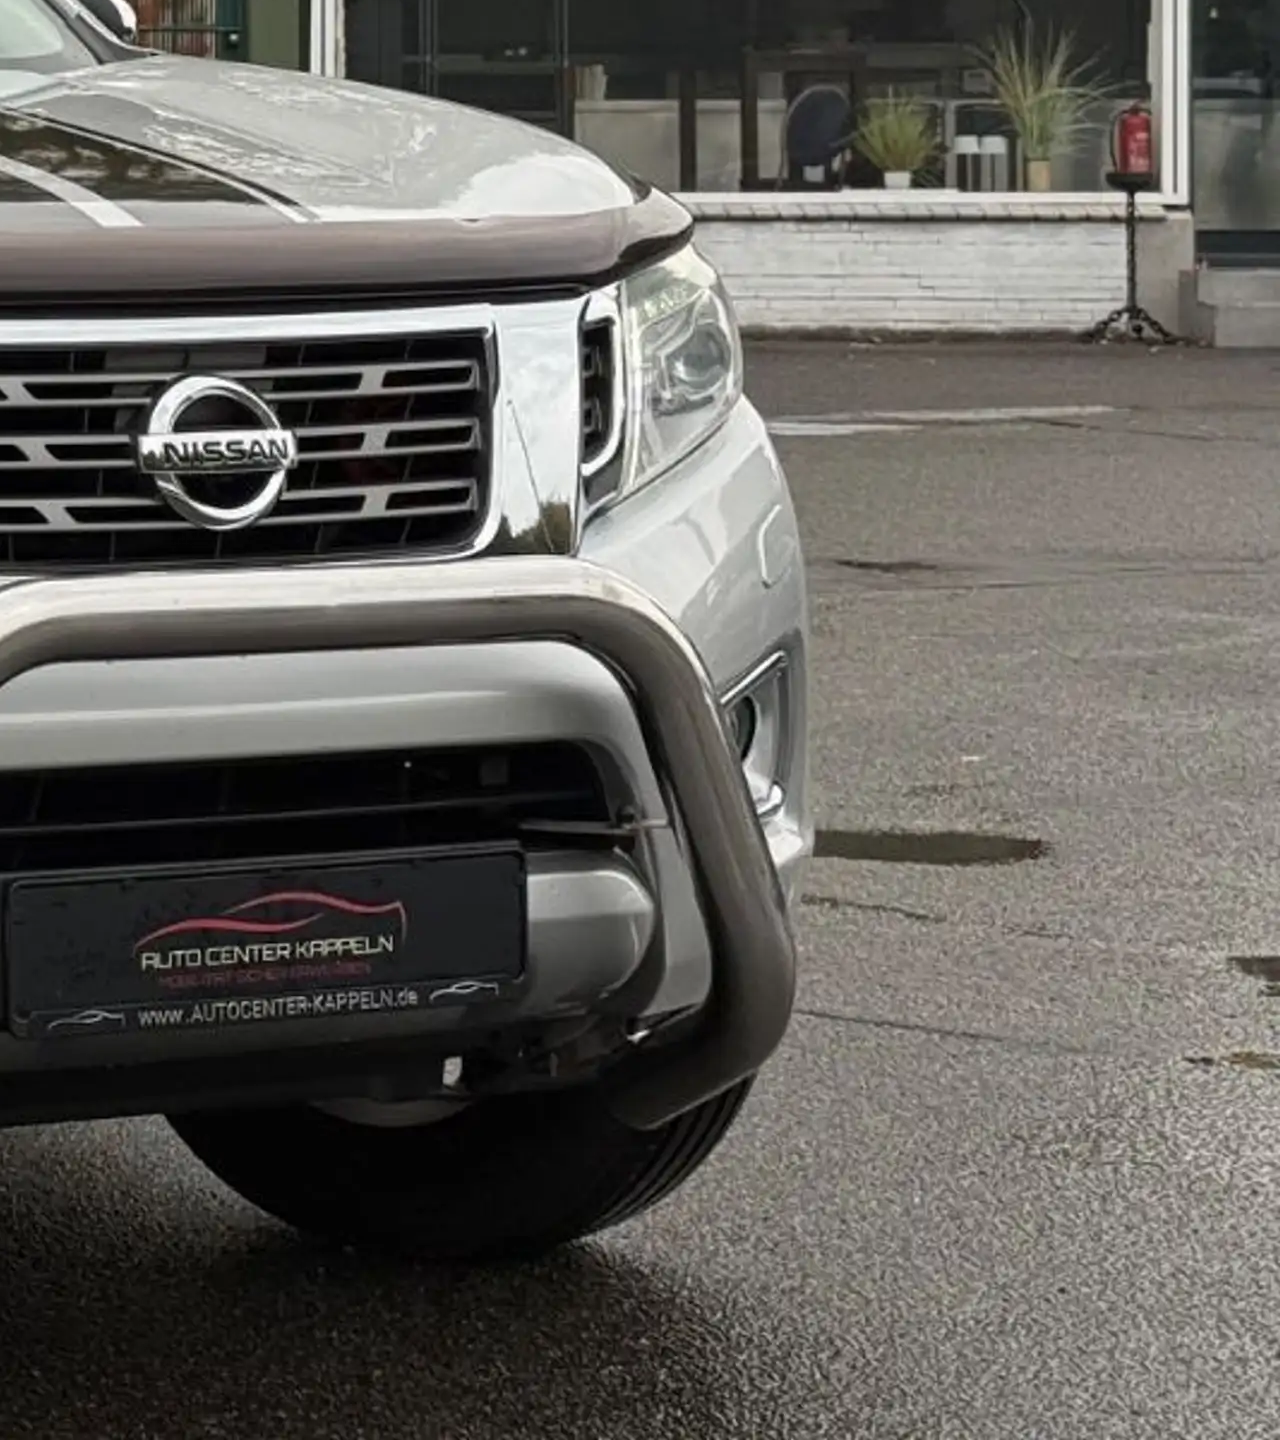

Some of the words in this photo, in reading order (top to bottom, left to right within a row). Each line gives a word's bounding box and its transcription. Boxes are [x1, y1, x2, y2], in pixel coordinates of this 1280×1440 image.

[164, 439, 287, 464] NISSAN
[142, 949, 201, 971] AUTO
[205, 943, 291, 966] CENTER
[296, 935, 393, 959] KAPPELN
